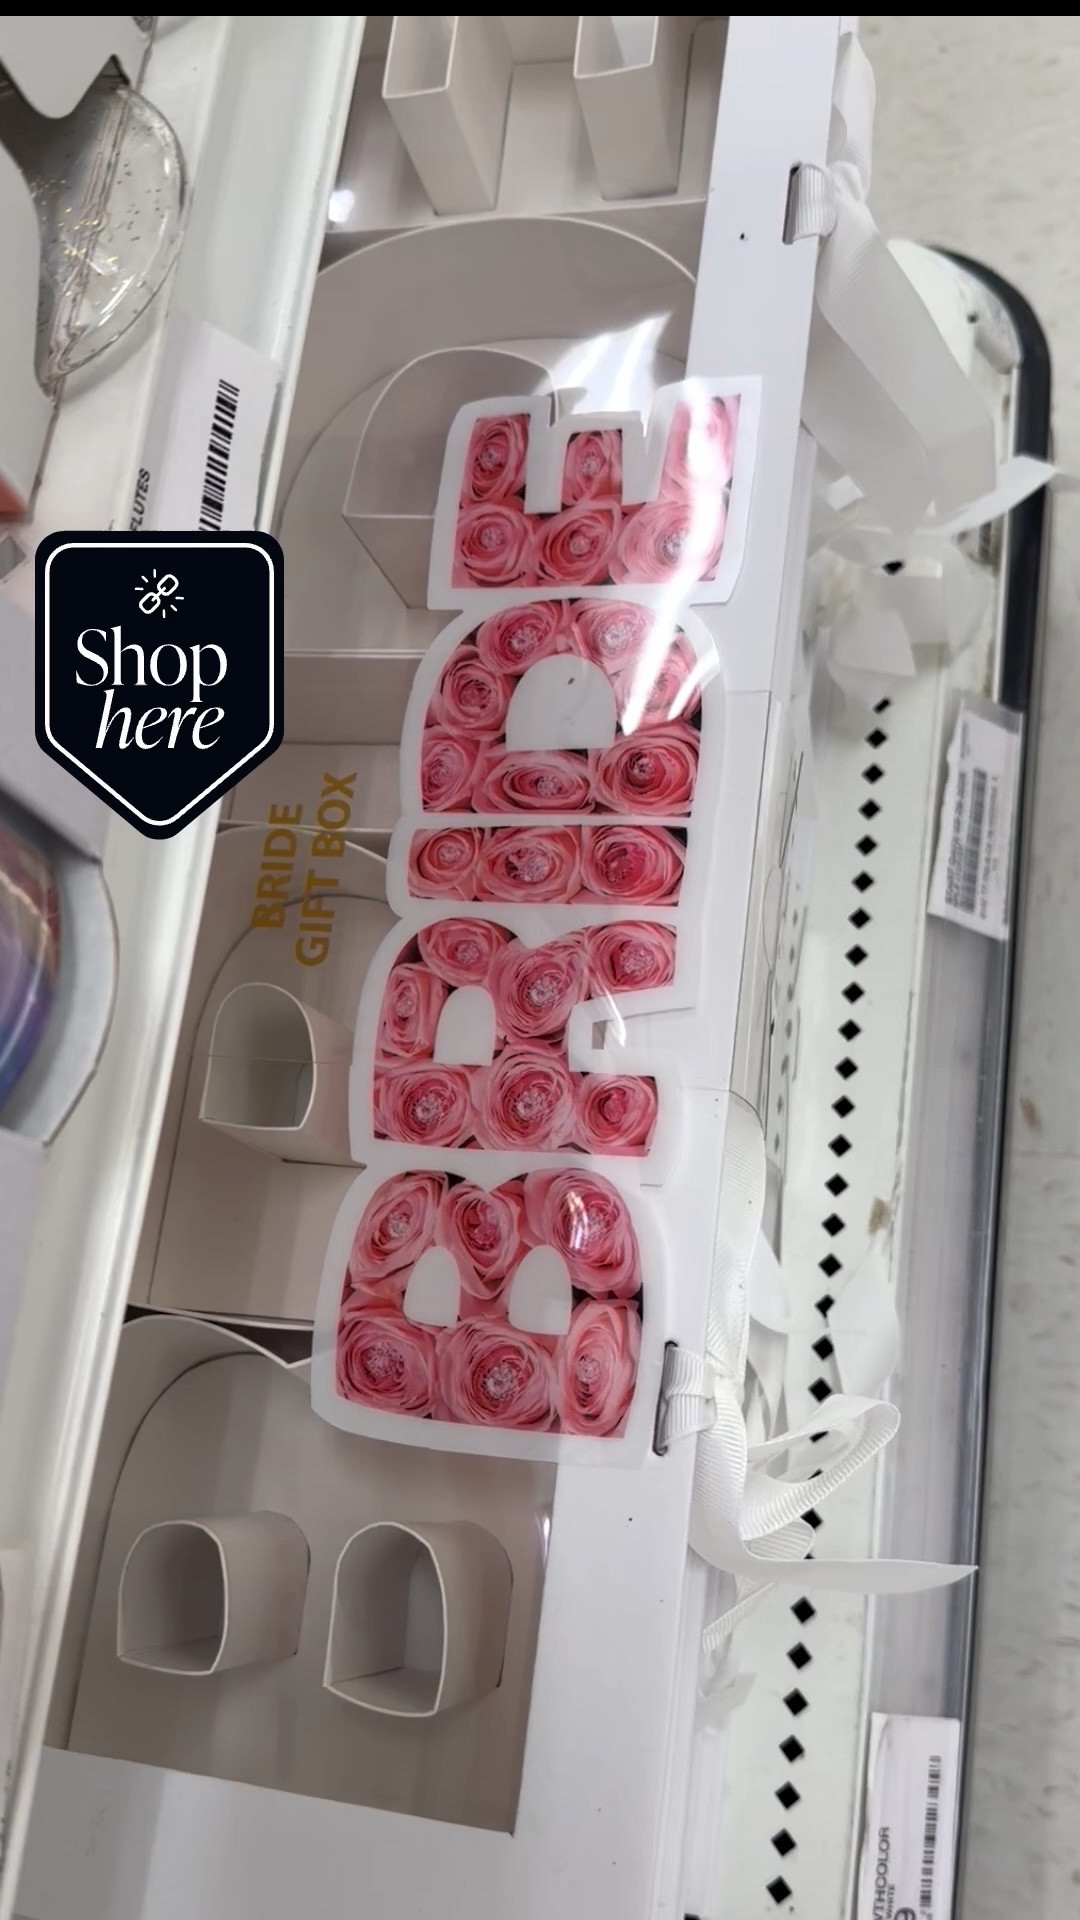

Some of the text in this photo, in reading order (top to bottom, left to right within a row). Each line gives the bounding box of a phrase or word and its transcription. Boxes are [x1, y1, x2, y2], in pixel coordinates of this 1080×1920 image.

[251, 804, 303, 928] BRIDE
[295, 772, 358, 967] GIFT BOX
[335, 393, 742, 1439] BRIDE
